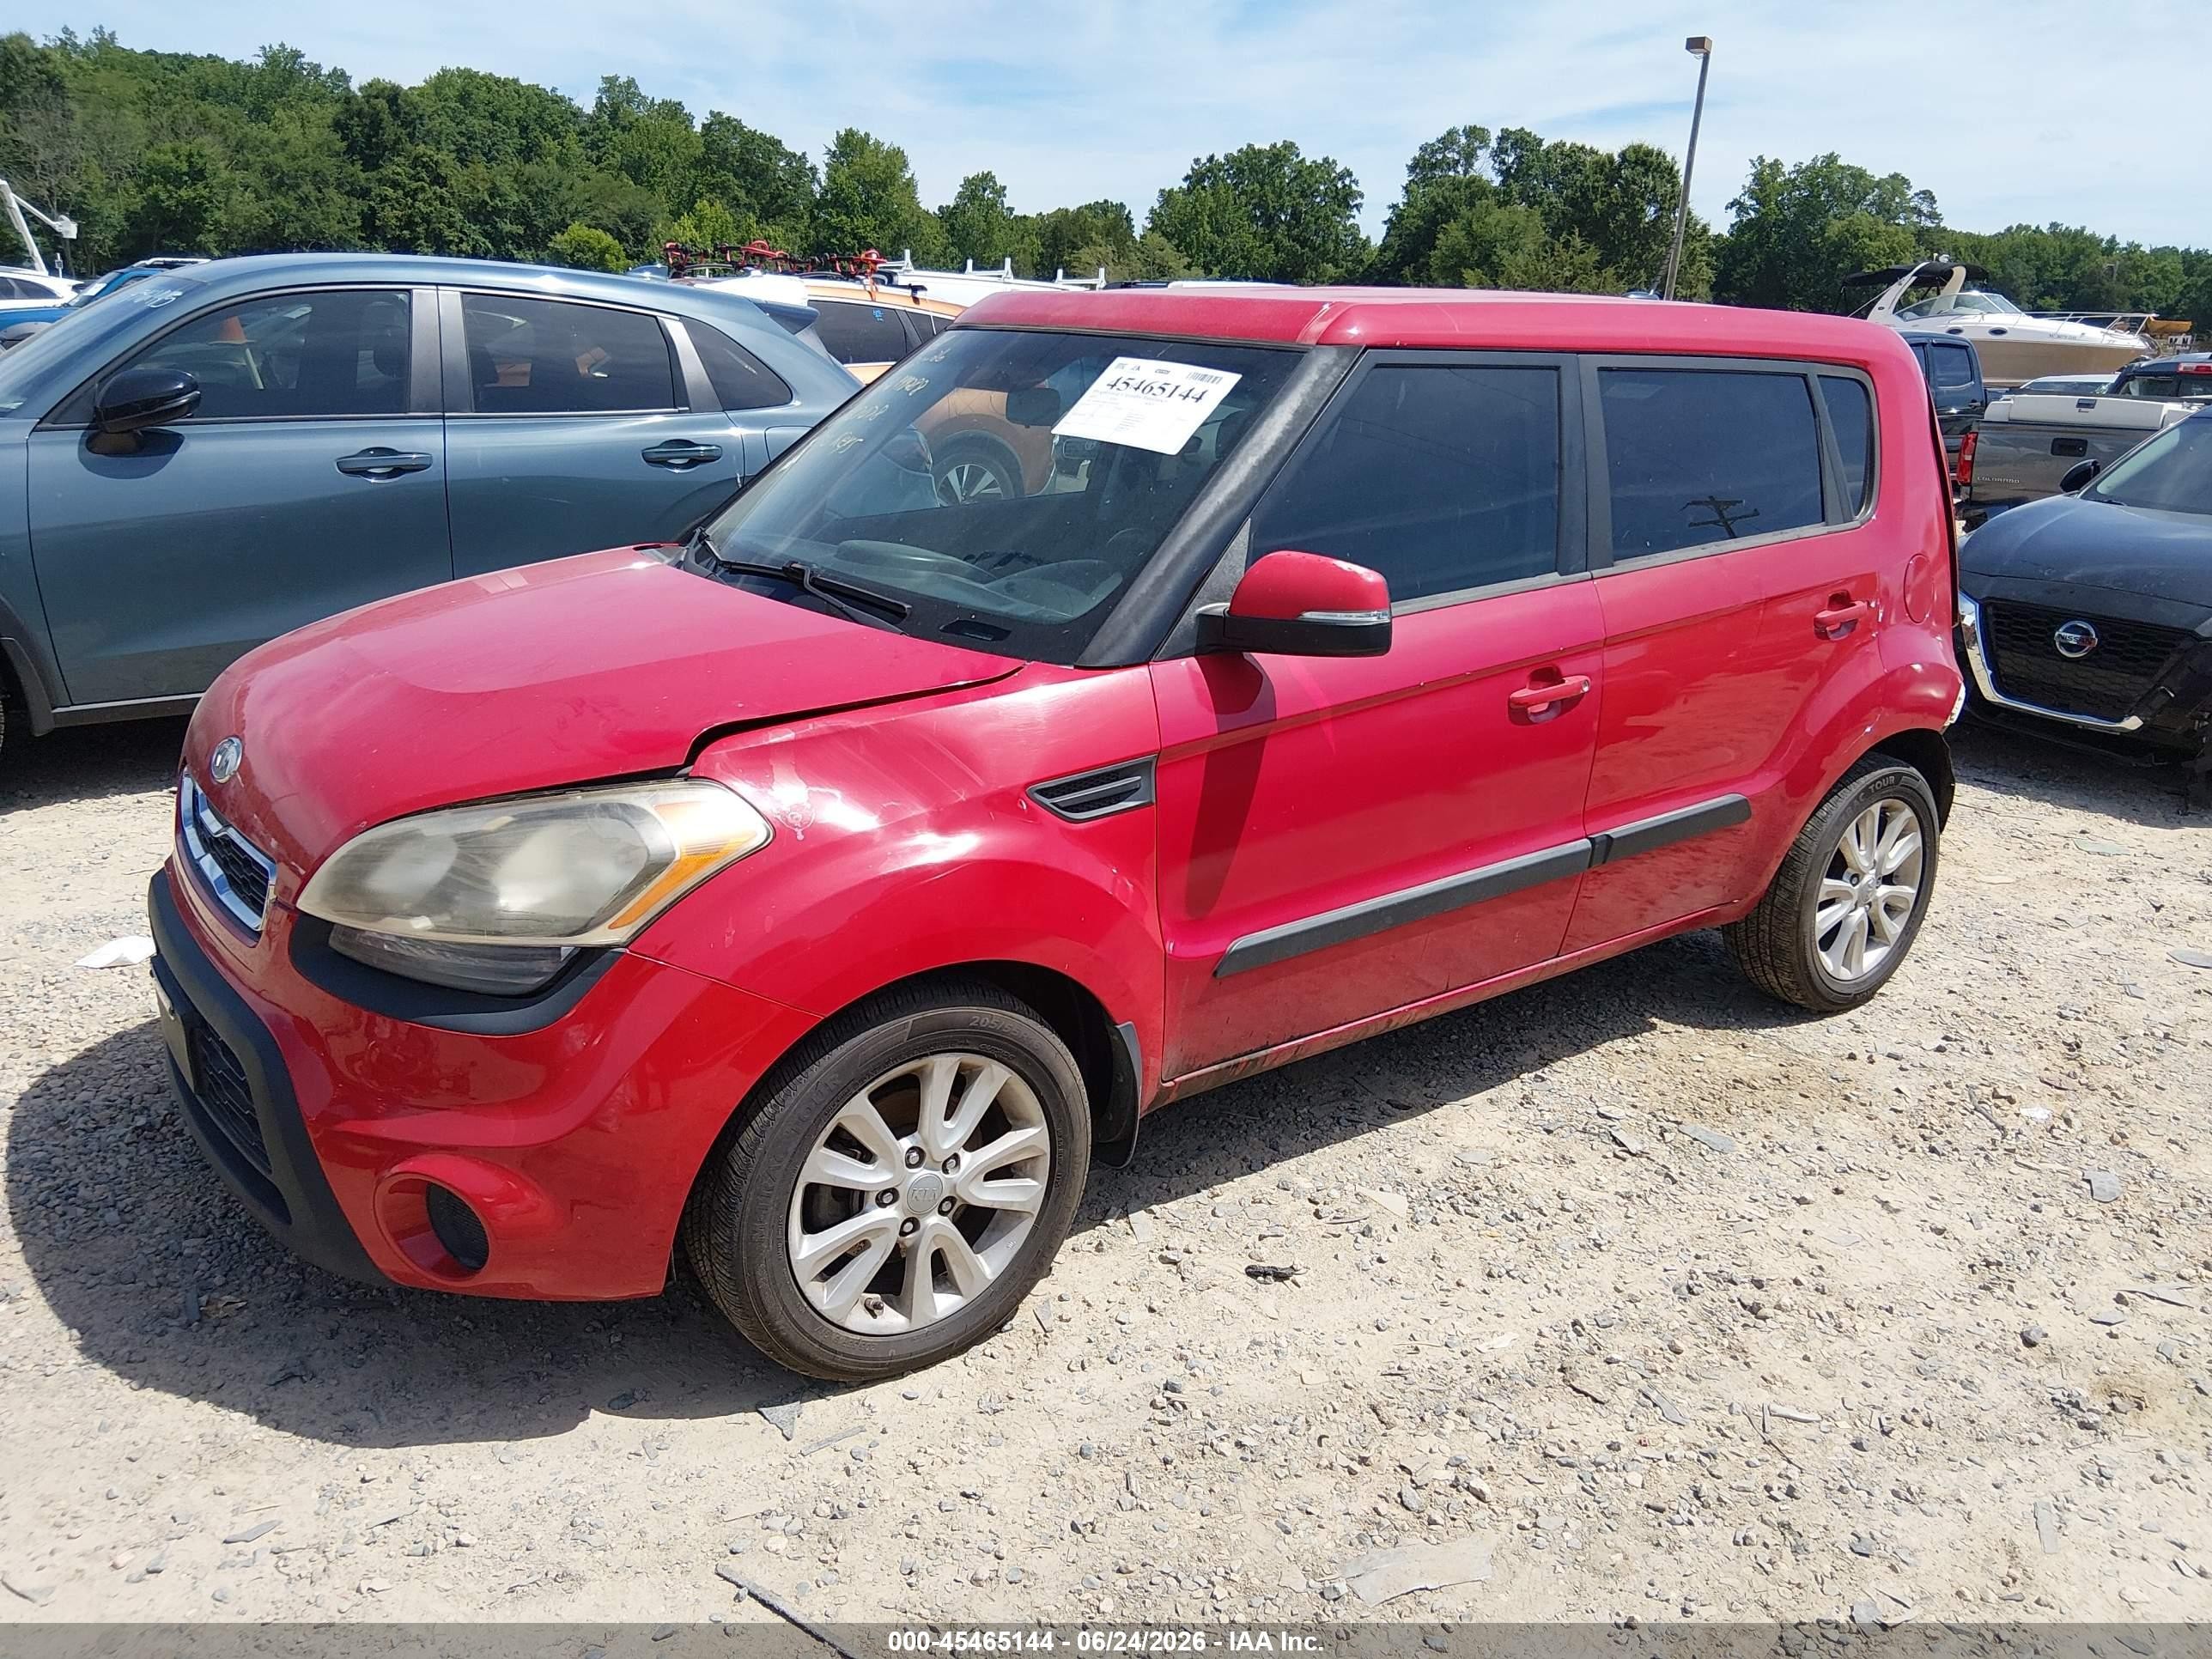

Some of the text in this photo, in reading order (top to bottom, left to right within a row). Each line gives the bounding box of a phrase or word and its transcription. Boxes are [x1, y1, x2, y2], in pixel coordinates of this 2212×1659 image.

[1106, 376, 1208, 404] 45465144
[1869, 775, 1895, 793] TOUR
[912, 1188, 938, 1201] KIA
